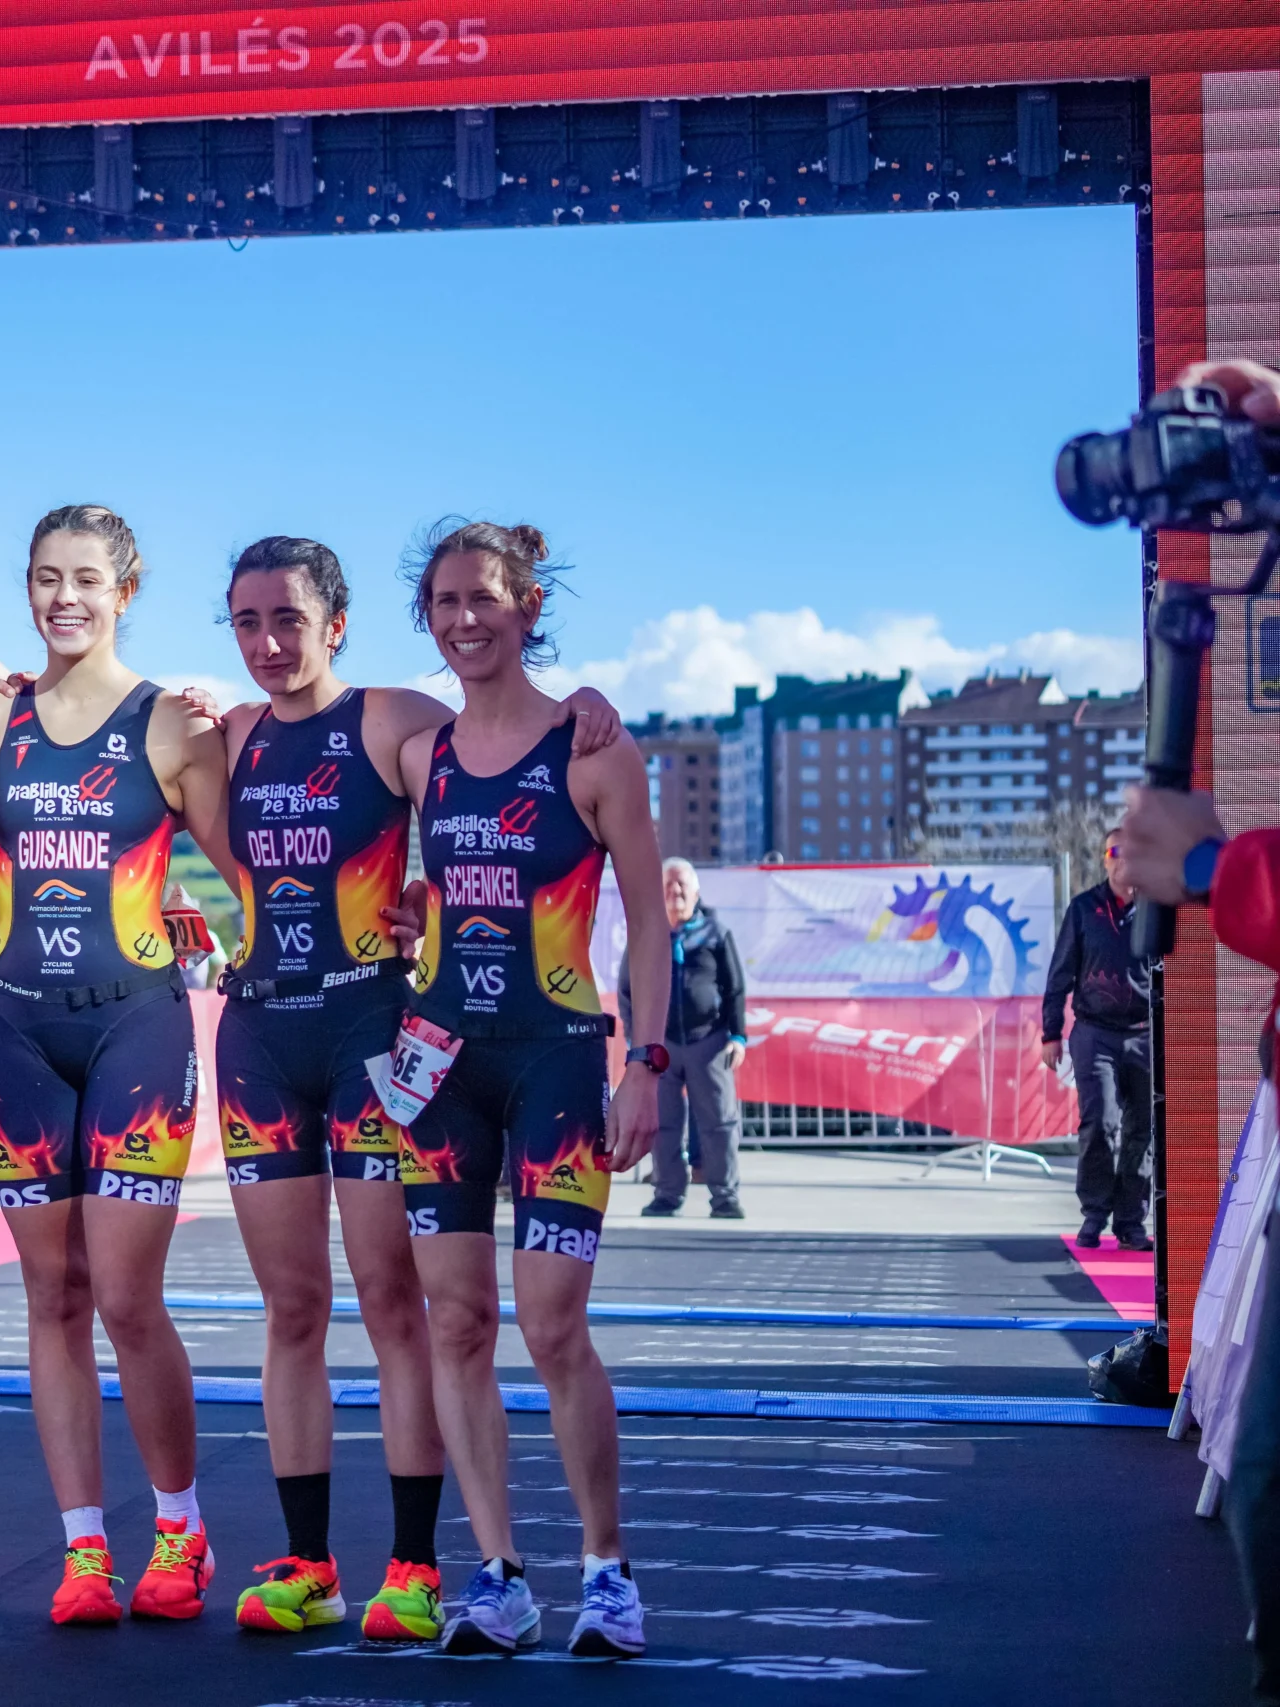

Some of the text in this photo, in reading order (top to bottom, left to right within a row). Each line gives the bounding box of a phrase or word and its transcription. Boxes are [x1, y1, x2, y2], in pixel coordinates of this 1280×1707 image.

[84, 16, 489, 81] AVILÉS 2025
[18, 830, 111, 870] GUISANDE
[247, 826, 332, 867] DEL POZO
[444, 865, 526, 908] SCHENKEL
[4, 982, 42, 1000] Kalenji
[322, 961, 380, 989] Santini
[463, 1005, 498, 1013] BOUTIQUE
[465, 998, 496, 1006] CYCLING
